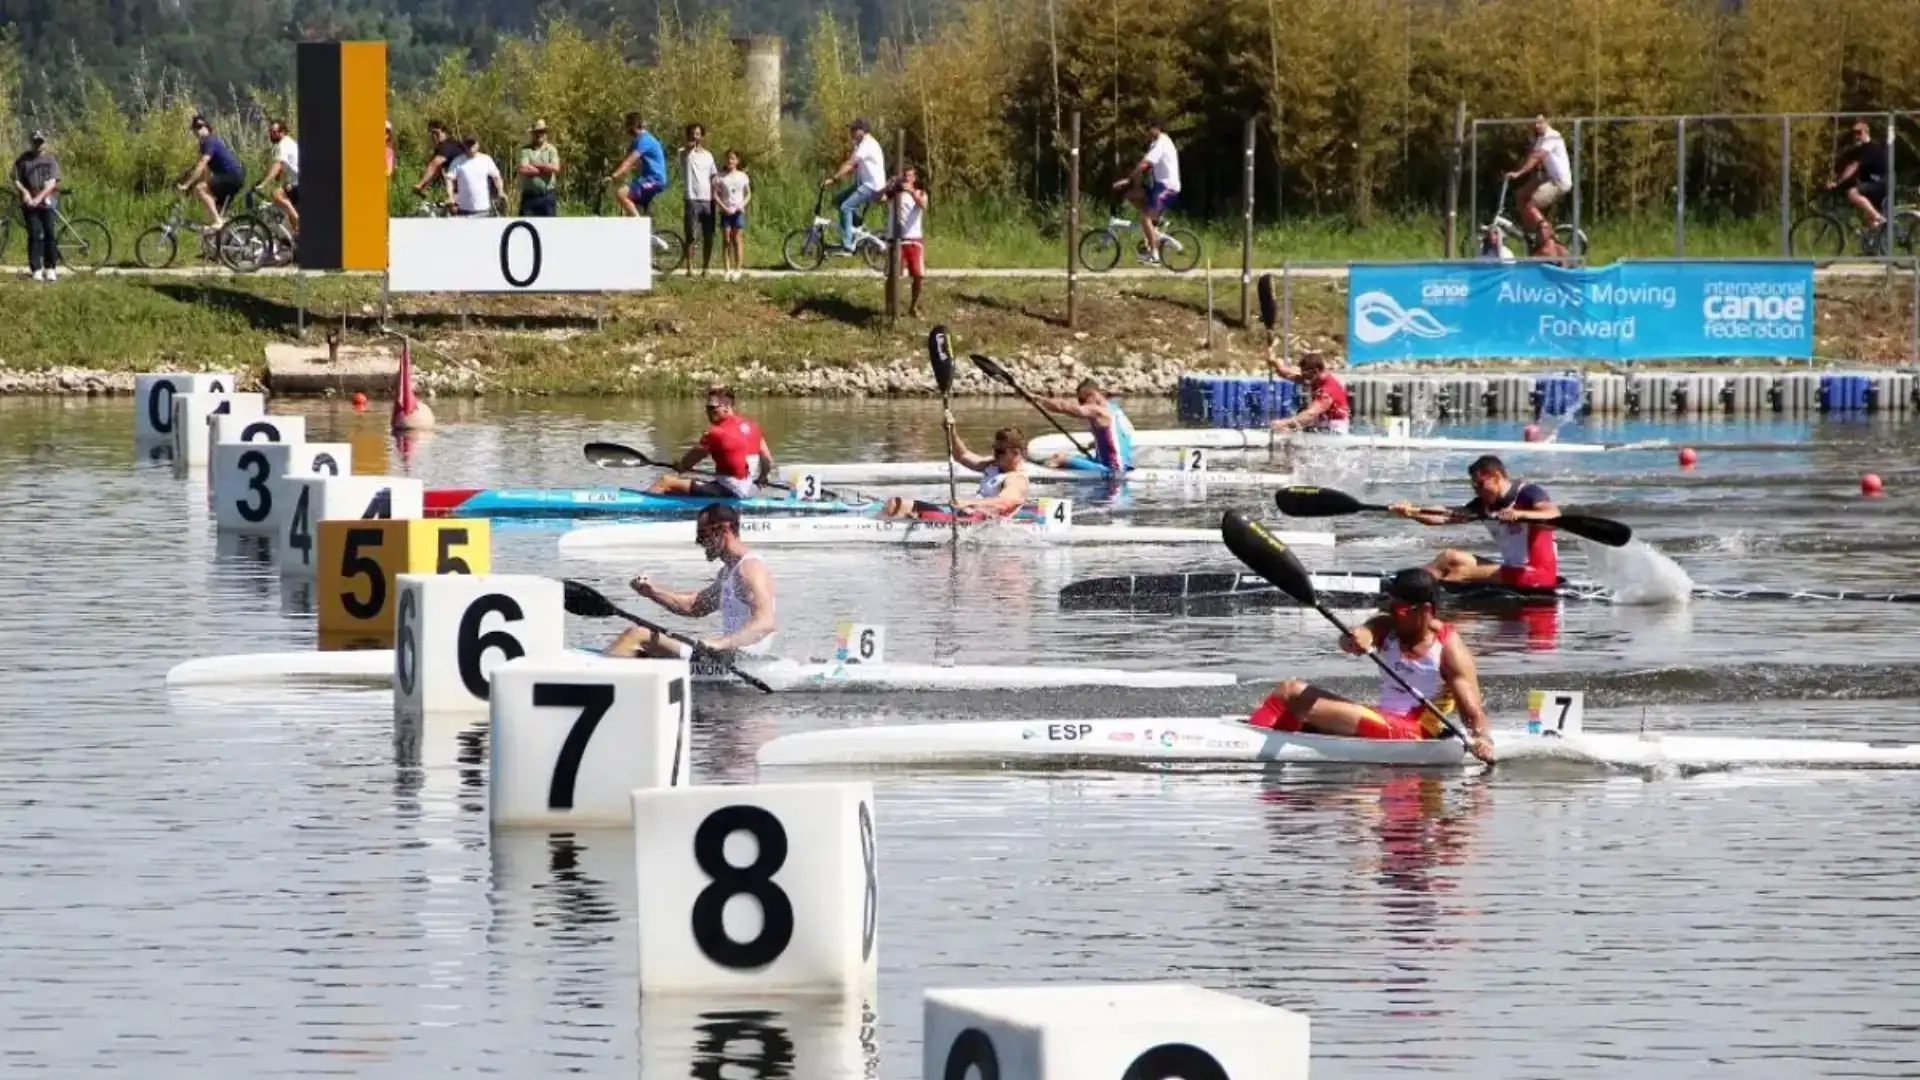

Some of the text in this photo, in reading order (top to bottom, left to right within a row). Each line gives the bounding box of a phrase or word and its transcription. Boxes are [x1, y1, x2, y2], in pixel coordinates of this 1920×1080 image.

[501, 220, 541, 287] 0
[1497, 281, 1676, 309] Always Moving
[1703, 280, 1806, 296] international
[1703, 296, 1805, 320] canoe
[1540, 316, 1636, 339] Forward
[1704, 320, 1805, 340] federation
[148, 379, 177, 433] 0
[1191, 450, 1203, 469] 2
[236, 451, 272, 523] 3
[804, 476, 816, 498] 3
[290, 484, 312, 566] 4
[740, 521, 771, 532] GER
[1053, 501, 1065, 524] 4
[340, 528, 386, 620] 5
[398, 588, 416, 697] 6
[457, 593, 525, 702] 6
[860, 628, 875, 659] 6
[1555, 696, 1572, 730] 7
[532, 683, 616, 810] 7
[1048, 724, 1092, 741] ESP
[691, 804, 795, 969] 8
[859, 800, 877, 963] 8
